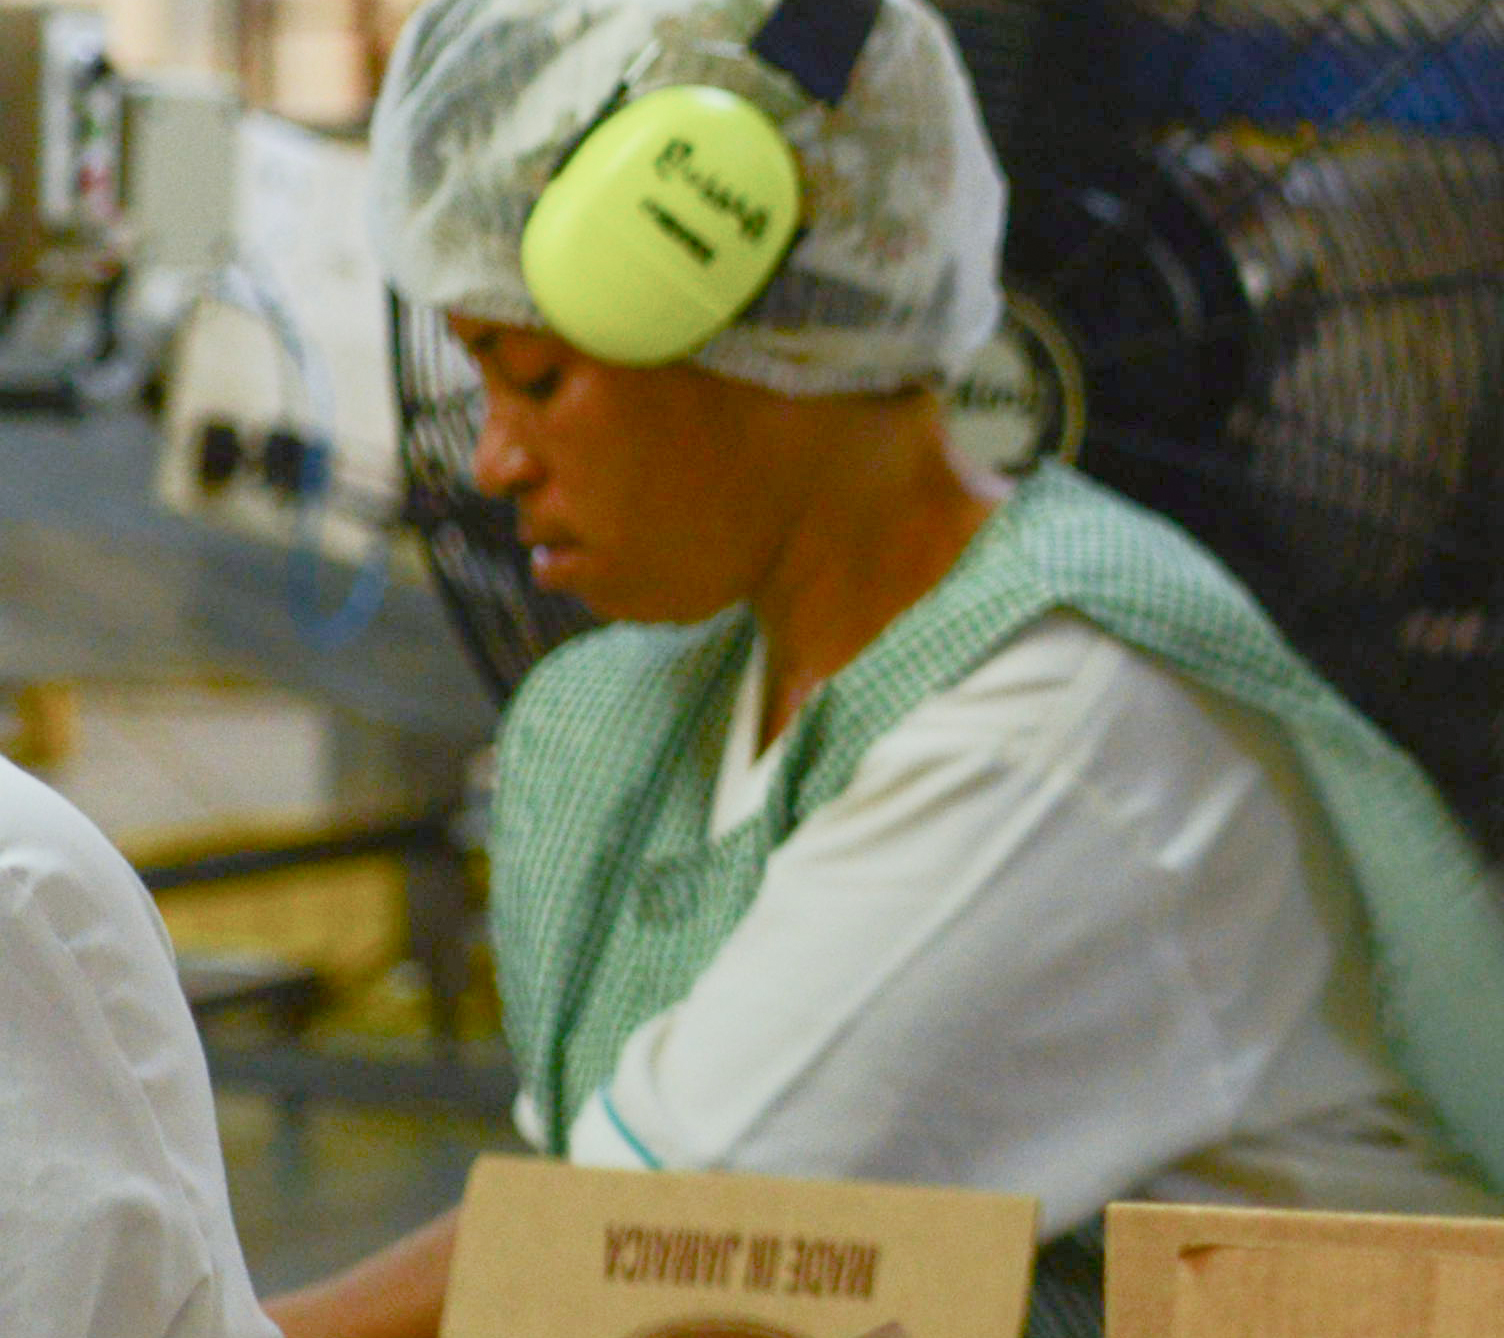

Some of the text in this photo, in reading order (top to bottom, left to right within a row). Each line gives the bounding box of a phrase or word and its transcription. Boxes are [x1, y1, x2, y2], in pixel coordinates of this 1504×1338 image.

[604, 1223, 880, 1301] MADE IN JAMAICA
